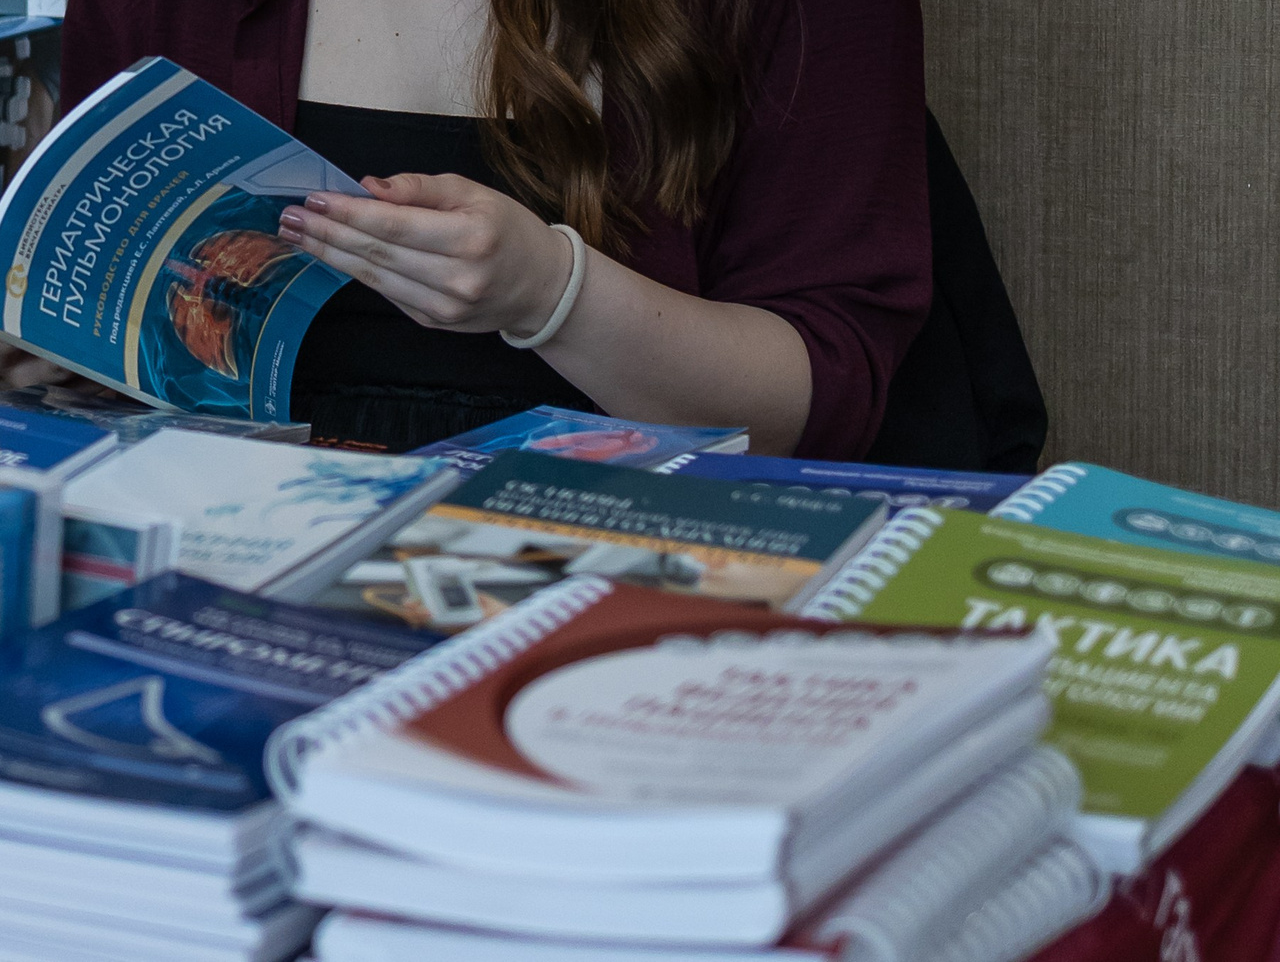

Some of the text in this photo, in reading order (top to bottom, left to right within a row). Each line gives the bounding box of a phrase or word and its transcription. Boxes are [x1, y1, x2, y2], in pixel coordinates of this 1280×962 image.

[17, 195, 51, 256] БИБЛИОТЕКА
[23, 183, 68, 261] ВРАЧА-ГЕРИАТРА
[38, 108, 199, 318] ГЕРИАТРИЧЕСКАЯ
[62, 113, 232, 329] ПУЛЬМОНОЛОГИЯ
[92, 169, 190, 338] РУКОВОДСТВО ДЛЯ ВРАЧЕЙ
[109, 155, 242, 345] Под редакцией Е.С. Лаптевой, А.Л. Арьева
[961, 597, 1239, 680] ТАКТИКА
